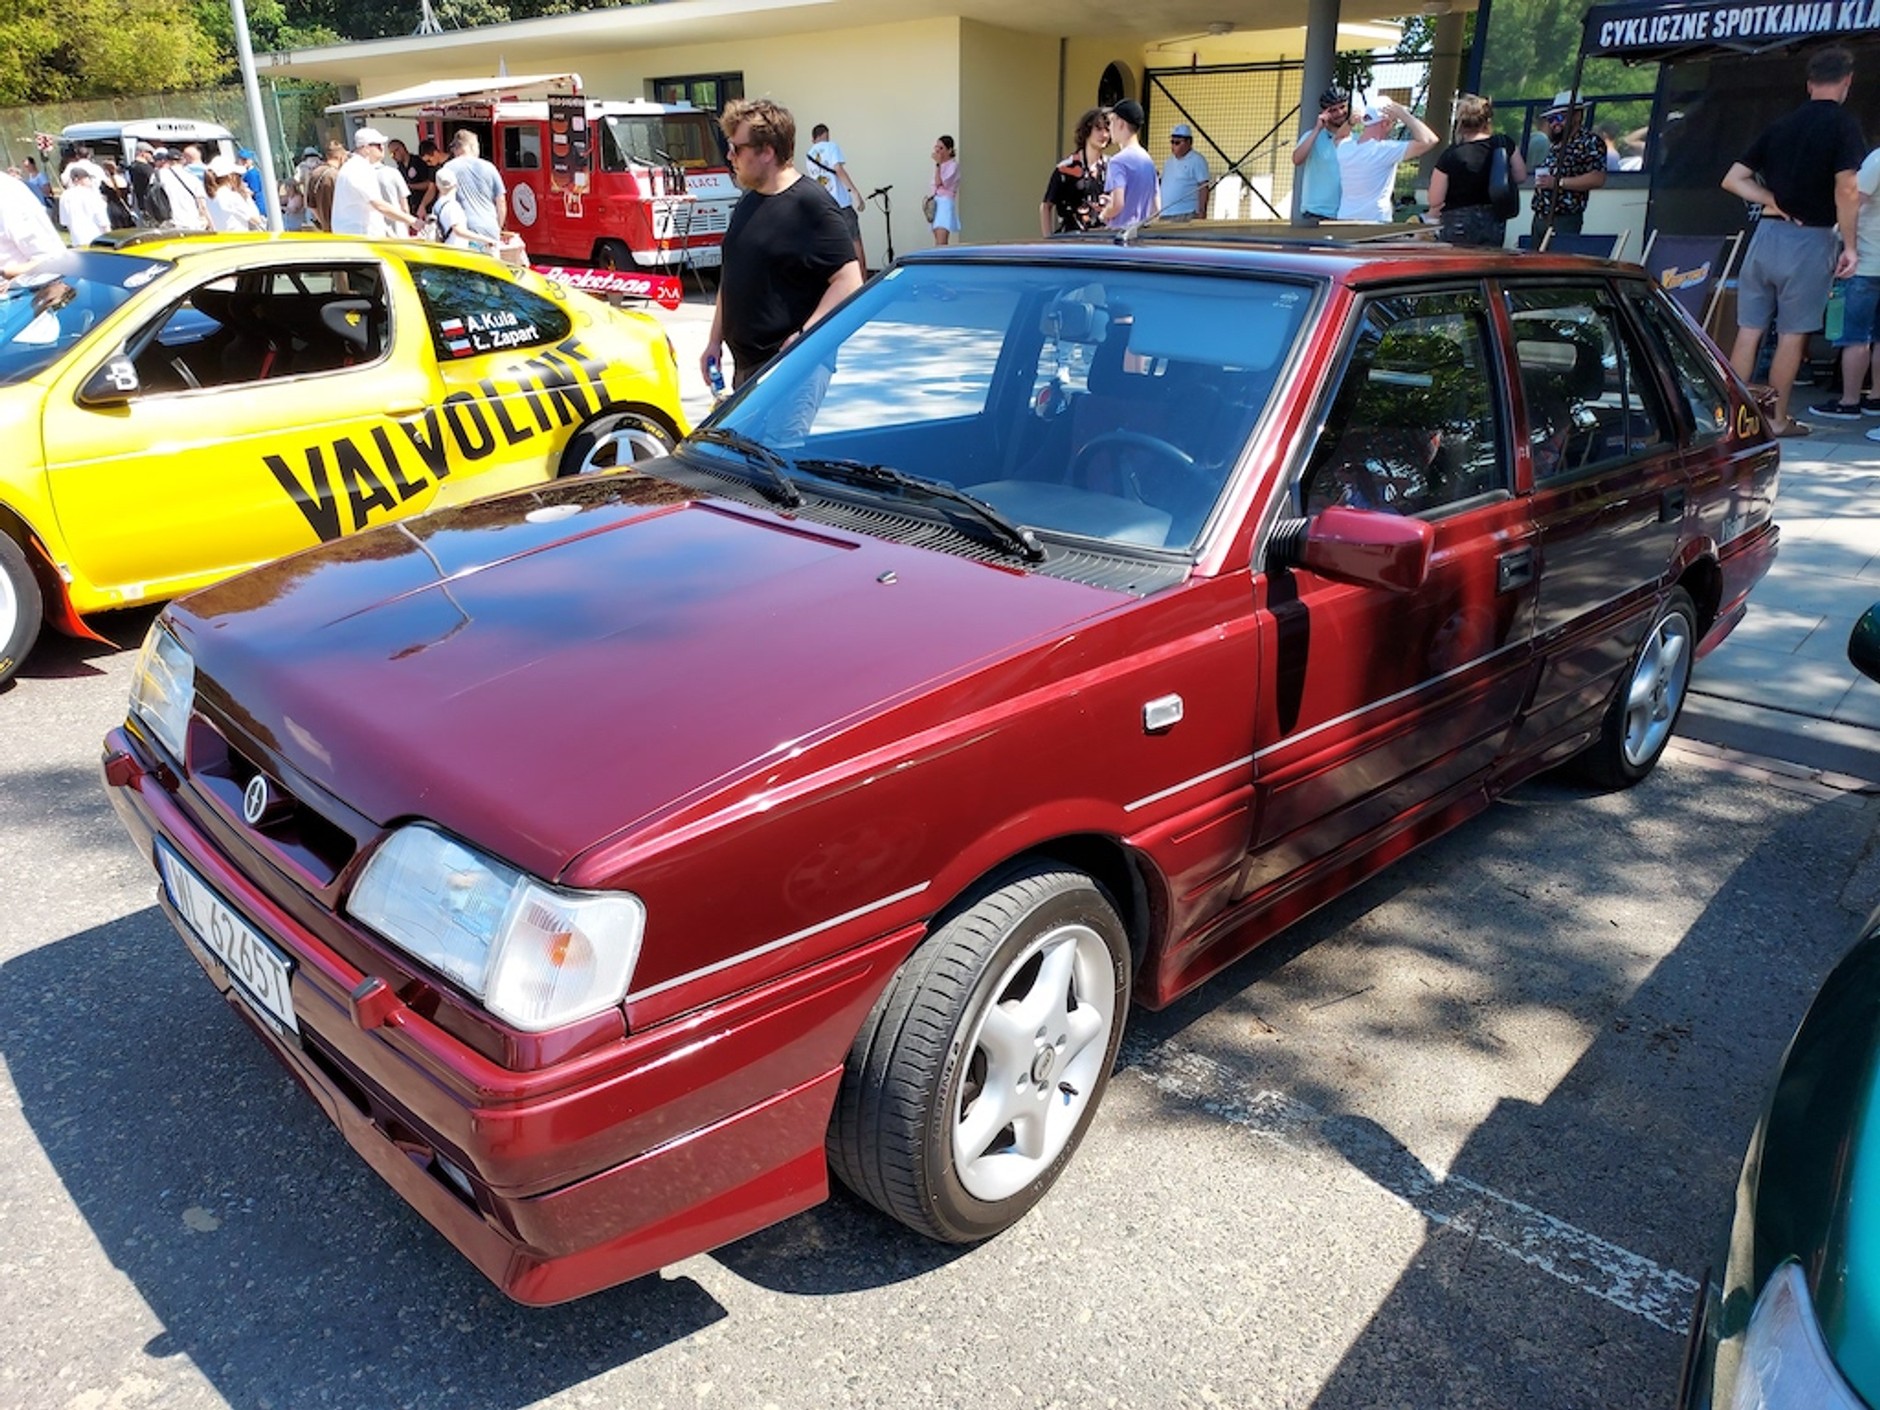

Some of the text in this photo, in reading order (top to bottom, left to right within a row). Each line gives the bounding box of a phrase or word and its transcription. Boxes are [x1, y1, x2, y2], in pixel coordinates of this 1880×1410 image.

[1600, 12, 1707, 47] CYKLICZNE
[1711, 2, 1832, 37] SPOTKANIA
[467, 311, 518, 332] A.Kula
[490, 325, 539, 347] Zapart
[262, 335, 611, 544] VALVOLINE
[210, 902, 285, 1015] 6265T
